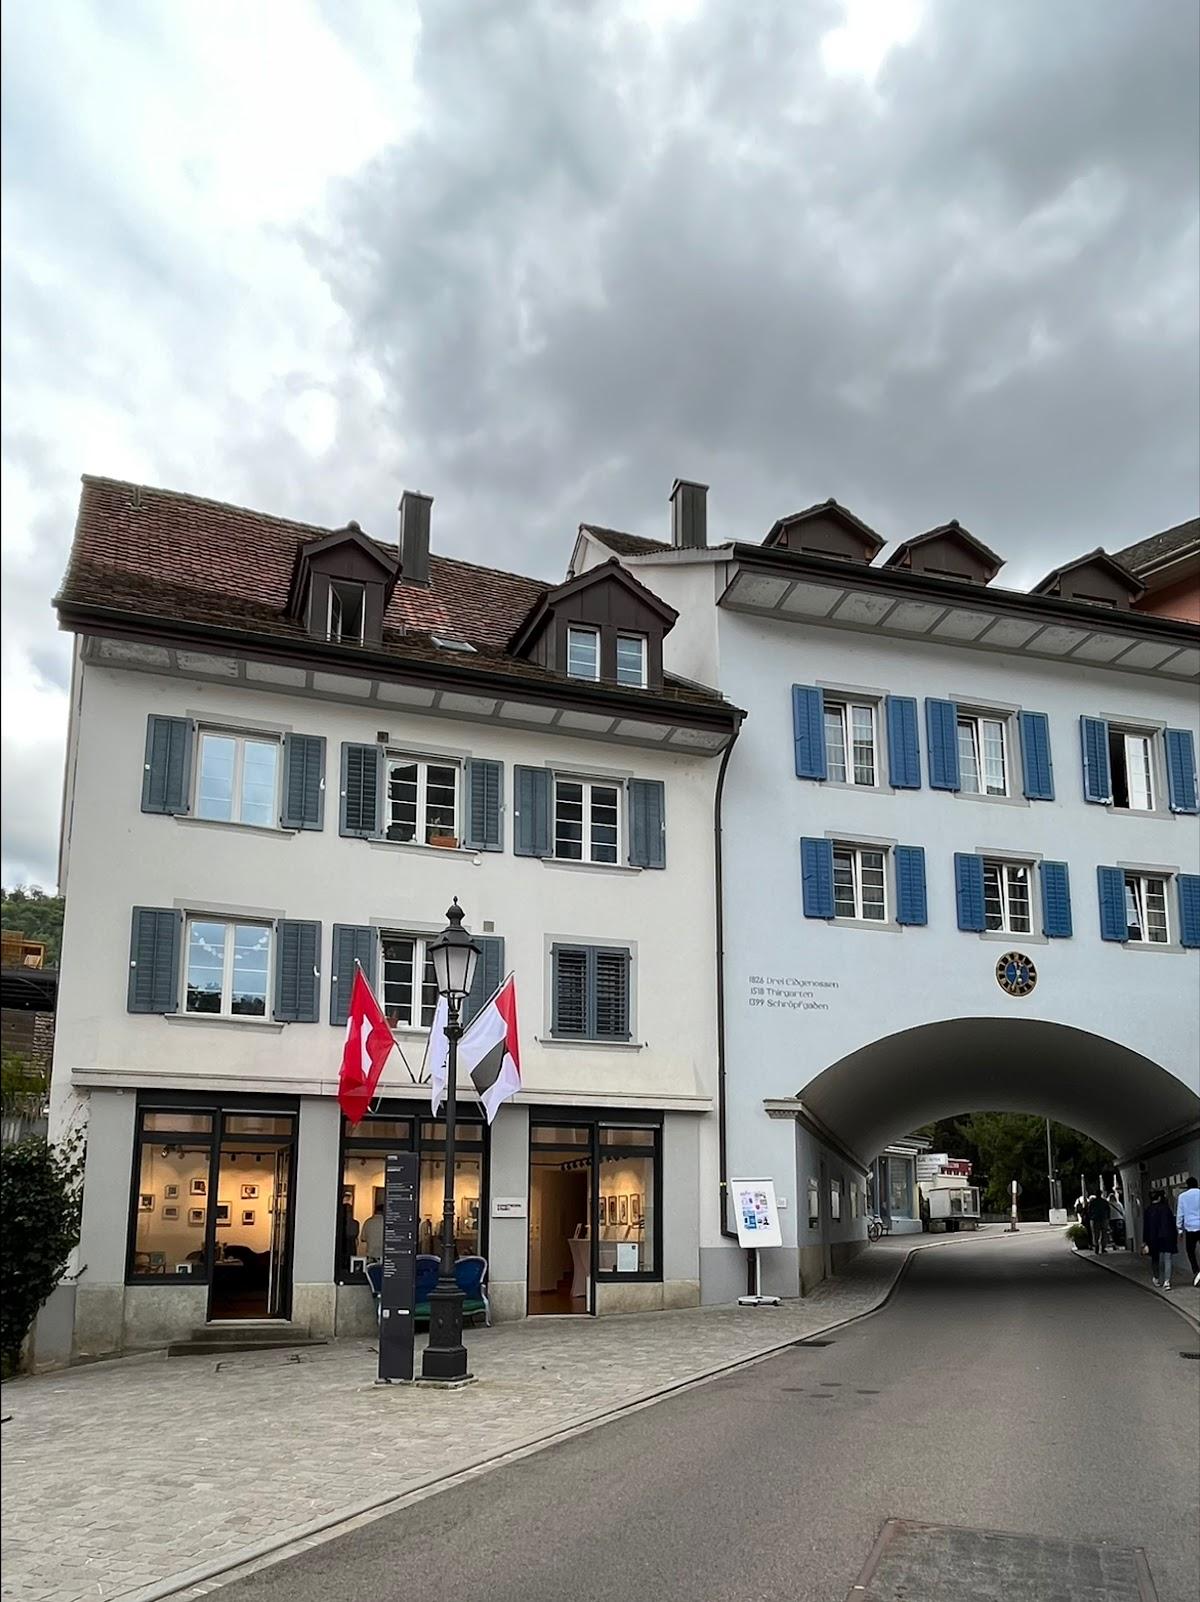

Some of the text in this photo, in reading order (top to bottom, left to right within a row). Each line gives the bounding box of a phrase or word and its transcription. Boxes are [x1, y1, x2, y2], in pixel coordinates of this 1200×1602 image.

[749, 976, 839, 988] 1826 Drei Eidgenossen
[749, 998, 765, 1006] 1399
